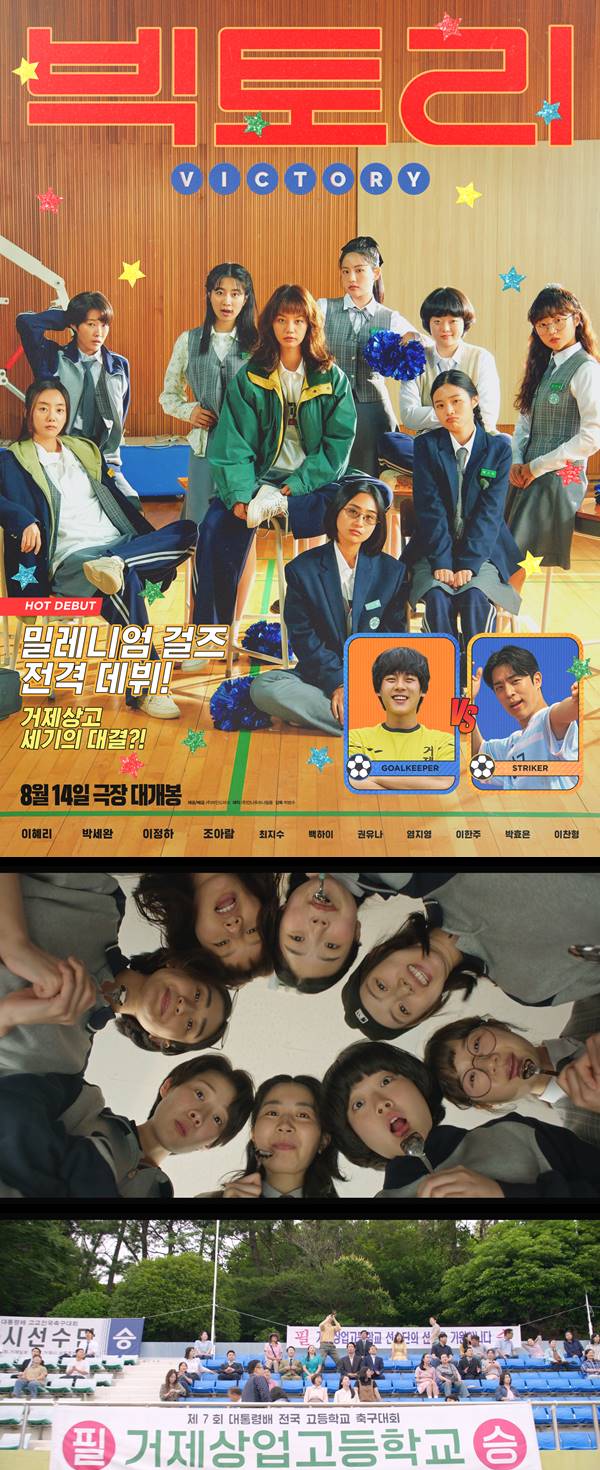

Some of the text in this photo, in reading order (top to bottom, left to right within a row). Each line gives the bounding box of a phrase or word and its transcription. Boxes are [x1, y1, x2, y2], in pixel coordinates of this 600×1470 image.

[27, 24, 574, 147] 빅토리
[178, 169, 423, 190] VICTORY
[24, 601, 97, 611] HOT DEBUT
[21, 625, 228, 660] 밀레니엄 걸즈
[21, 662, 174, 696] 전격 데뷔!
[20, 707, 103, 728] 거제상고
[450, 697, 479, 734] VS
[20, 729, 147, 750] 세기의 대결?!
[381, 764, 440, 772] GOALKEEPER
[512, 764, 549, 772] STRIKER
[20, 784, 182, 806] 8월 14일 극장 대개봉
[21, 828, 52, 839] 이혜리
[82, 828, 113, 839] 박세완
[143, 828, 174, 839] 이정하
[203, 828, 235, 839] 조아람
[259, 829, 285, 839] 최지수
[357, 830, 383, 839] 권유나
[456, 830, 481, 839] 이한주
[112, 1327, 137, 1350] 승
[295, 1328, 310, 1346] 필
[187, 1412, 400, 1425] 제 7 회 대통령배 전국 고등학교 축구대회
[71, 1425, 518, 1469] 필 거제상업고등학교 승
